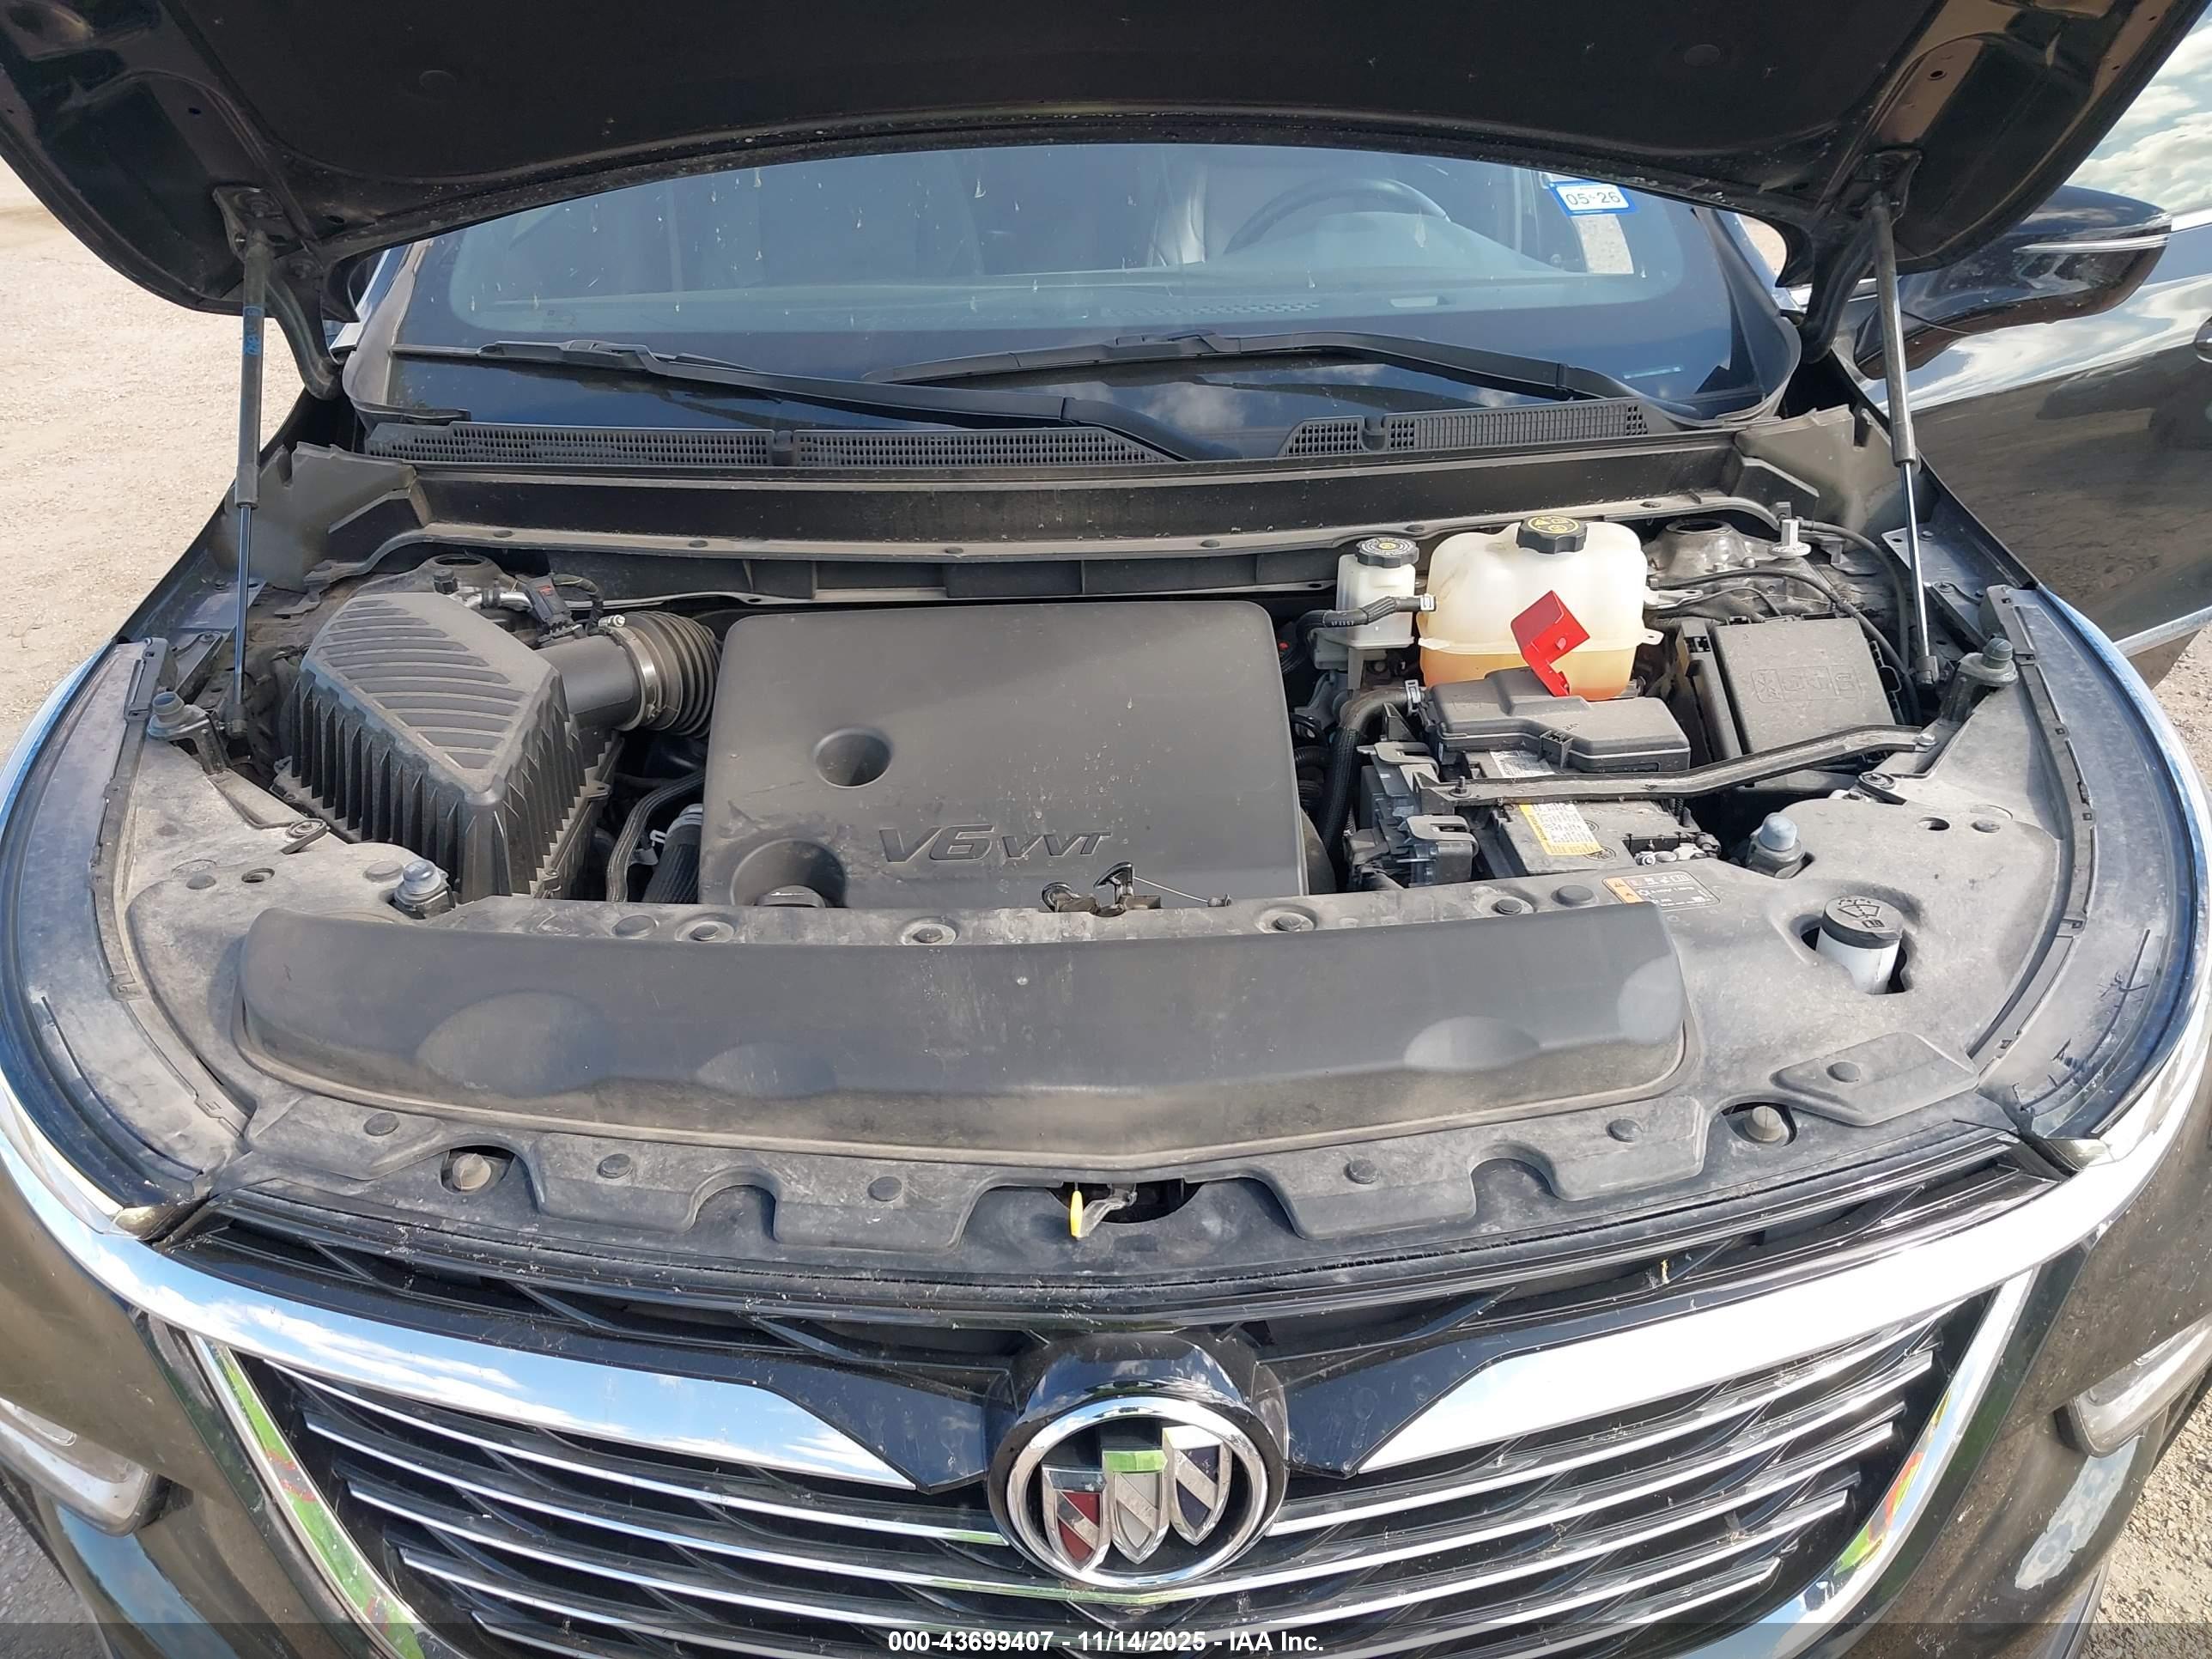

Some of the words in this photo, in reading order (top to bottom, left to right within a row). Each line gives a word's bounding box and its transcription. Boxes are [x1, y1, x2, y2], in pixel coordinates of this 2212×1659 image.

[1565, 193, 1589, 205] 05
[1597, 191, 1621, 204] 26
[878, 824, 994, 864] V6
[1001, 831, 1112, 858] VVT
